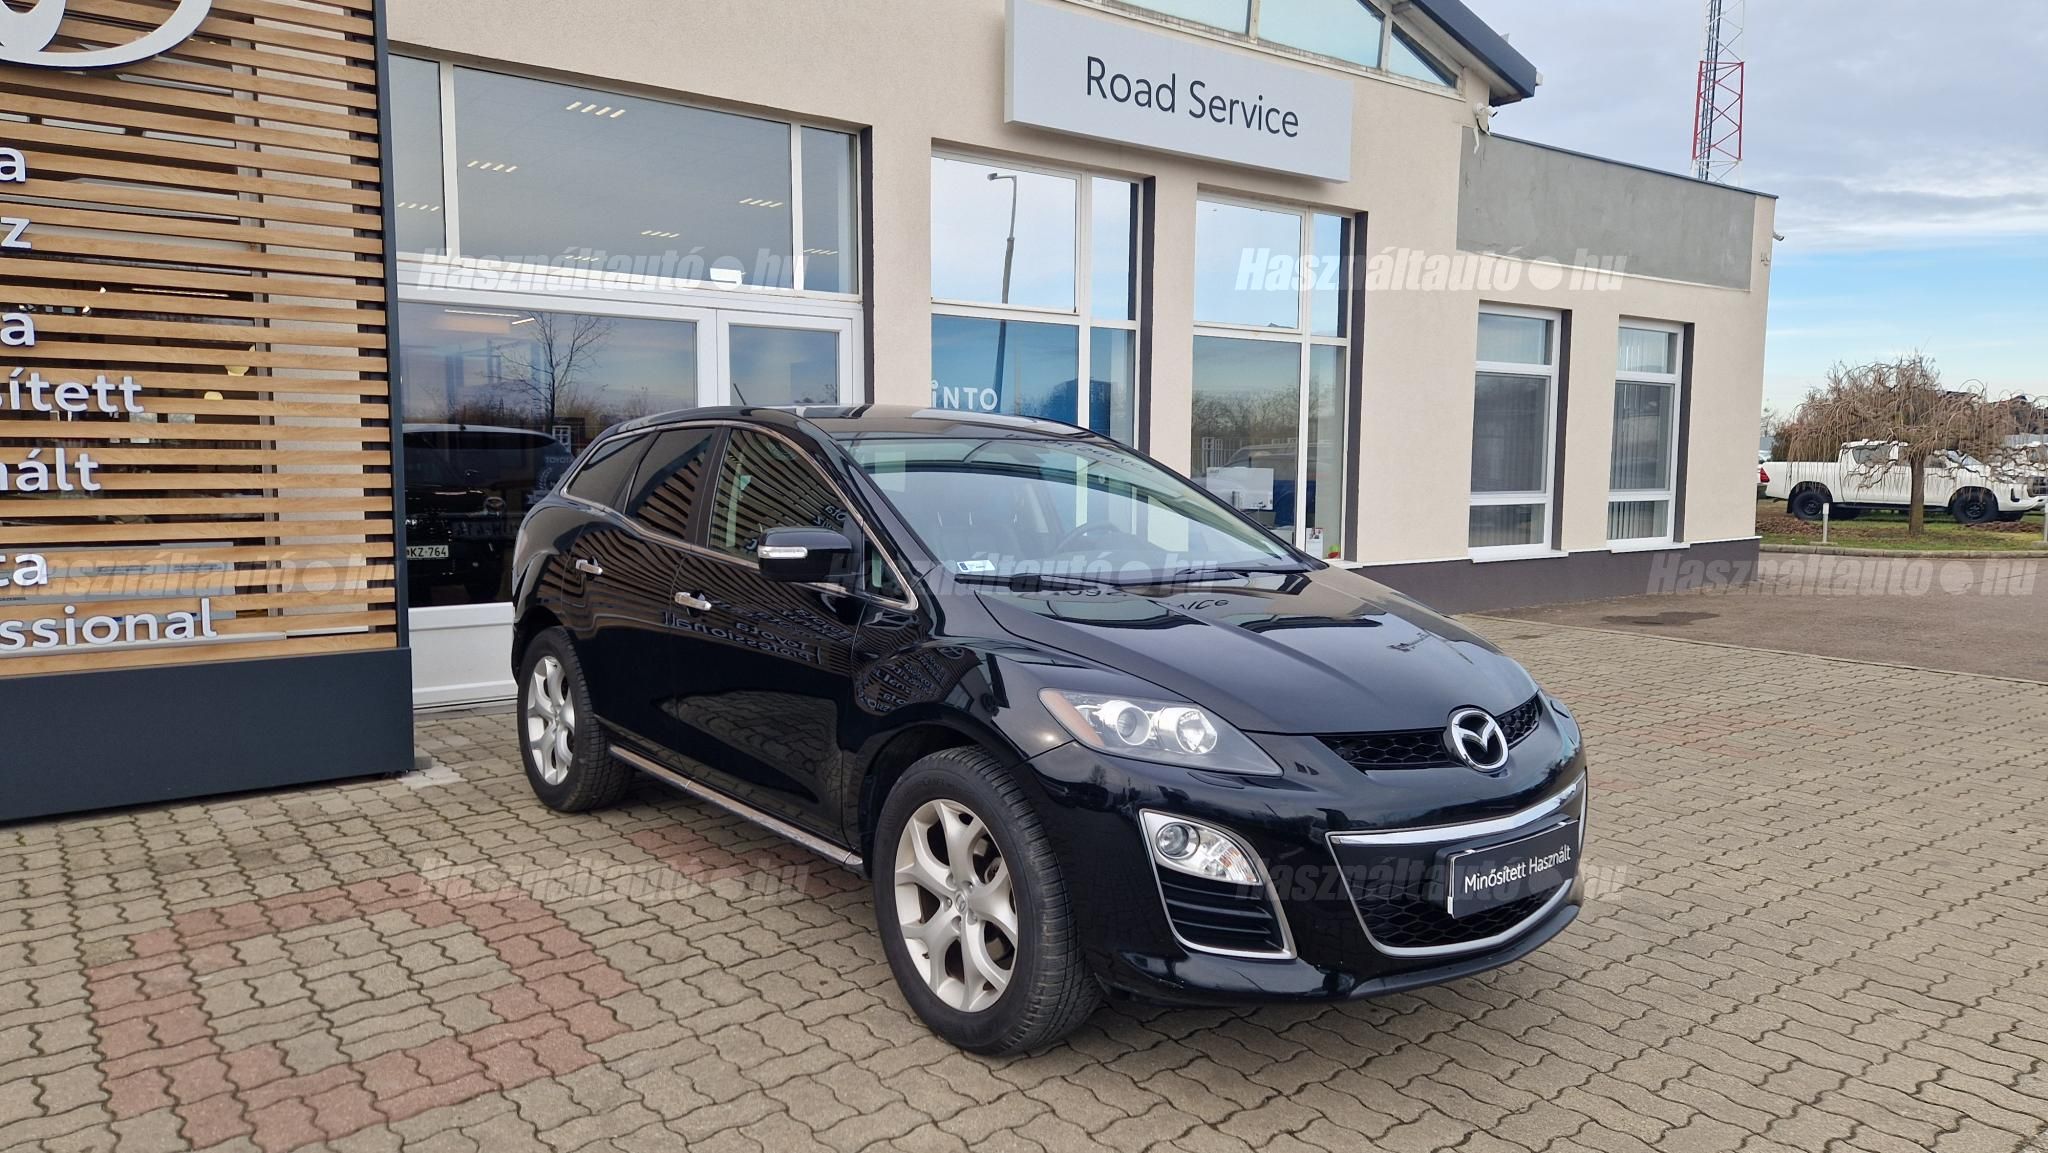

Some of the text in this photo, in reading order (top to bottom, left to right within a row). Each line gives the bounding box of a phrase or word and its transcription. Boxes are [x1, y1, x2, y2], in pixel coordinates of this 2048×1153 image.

[1086, 56, 1299, 138] Road Service
[0, 367, 145, 413] ített
[1464, 844, 1571, 894] Minősített Használt
